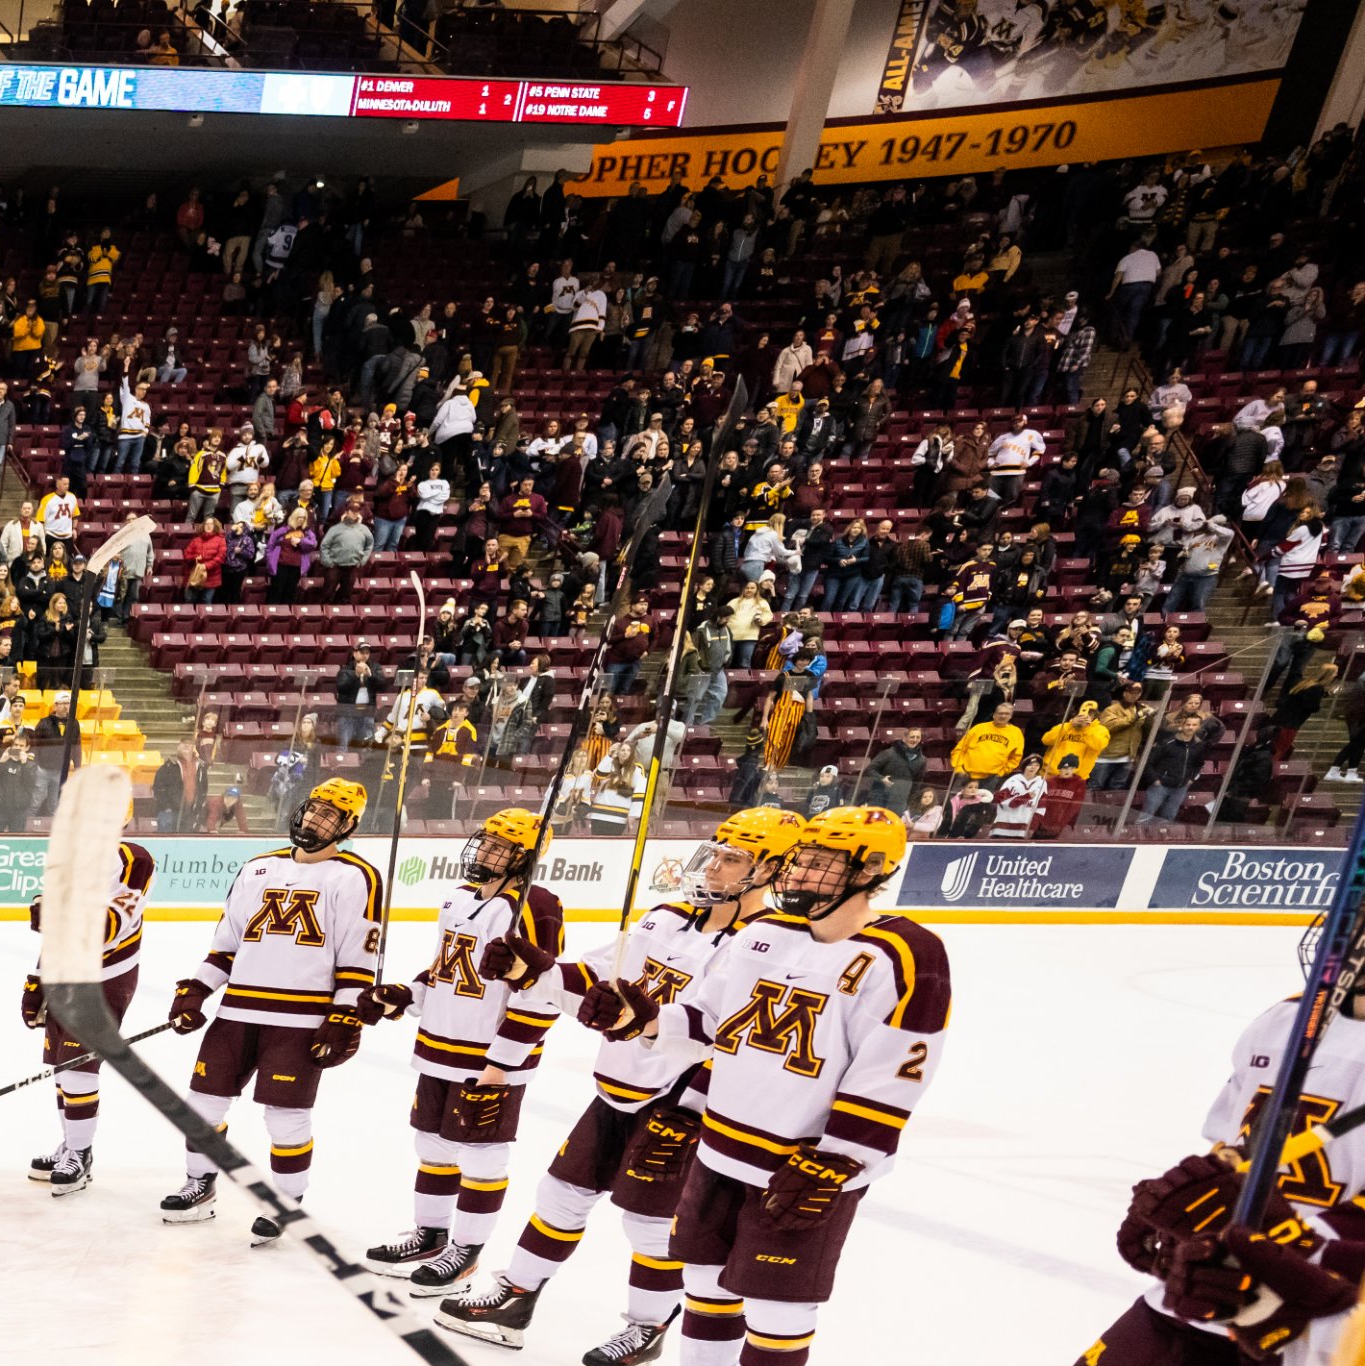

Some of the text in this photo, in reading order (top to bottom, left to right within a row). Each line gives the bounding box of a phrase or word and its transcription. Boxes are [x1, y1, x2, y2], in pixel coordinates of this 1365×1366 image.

[14, 70, 58, 101] THE
[57, 69, 136, 106] GAME
[482, 86, 489, 97] 1
[571, 88, 600, 99] STATE
[478, 103, 486, 114] 1
[578, 105, 607, 118] DAME
[878, 120, 1078, 166] 1947-1970
[977, 734, 1011, 749] MINNESOTA
[551, 858, 604, 882] Bank
[985, 855, 1051, 877] United
[1220, 851, 1325, 881] Boston
[977, 877, 1084, 901] Healthcare
[1190, 871, 1341, 906] Scientifi
[243, 889, 326, 947] M
[836, 951, 877, 997] A
[714, 979, 828, 1079] M
[896, 1041, 929, 1083] 2
[755, 1253, 798, 1266] CCM
